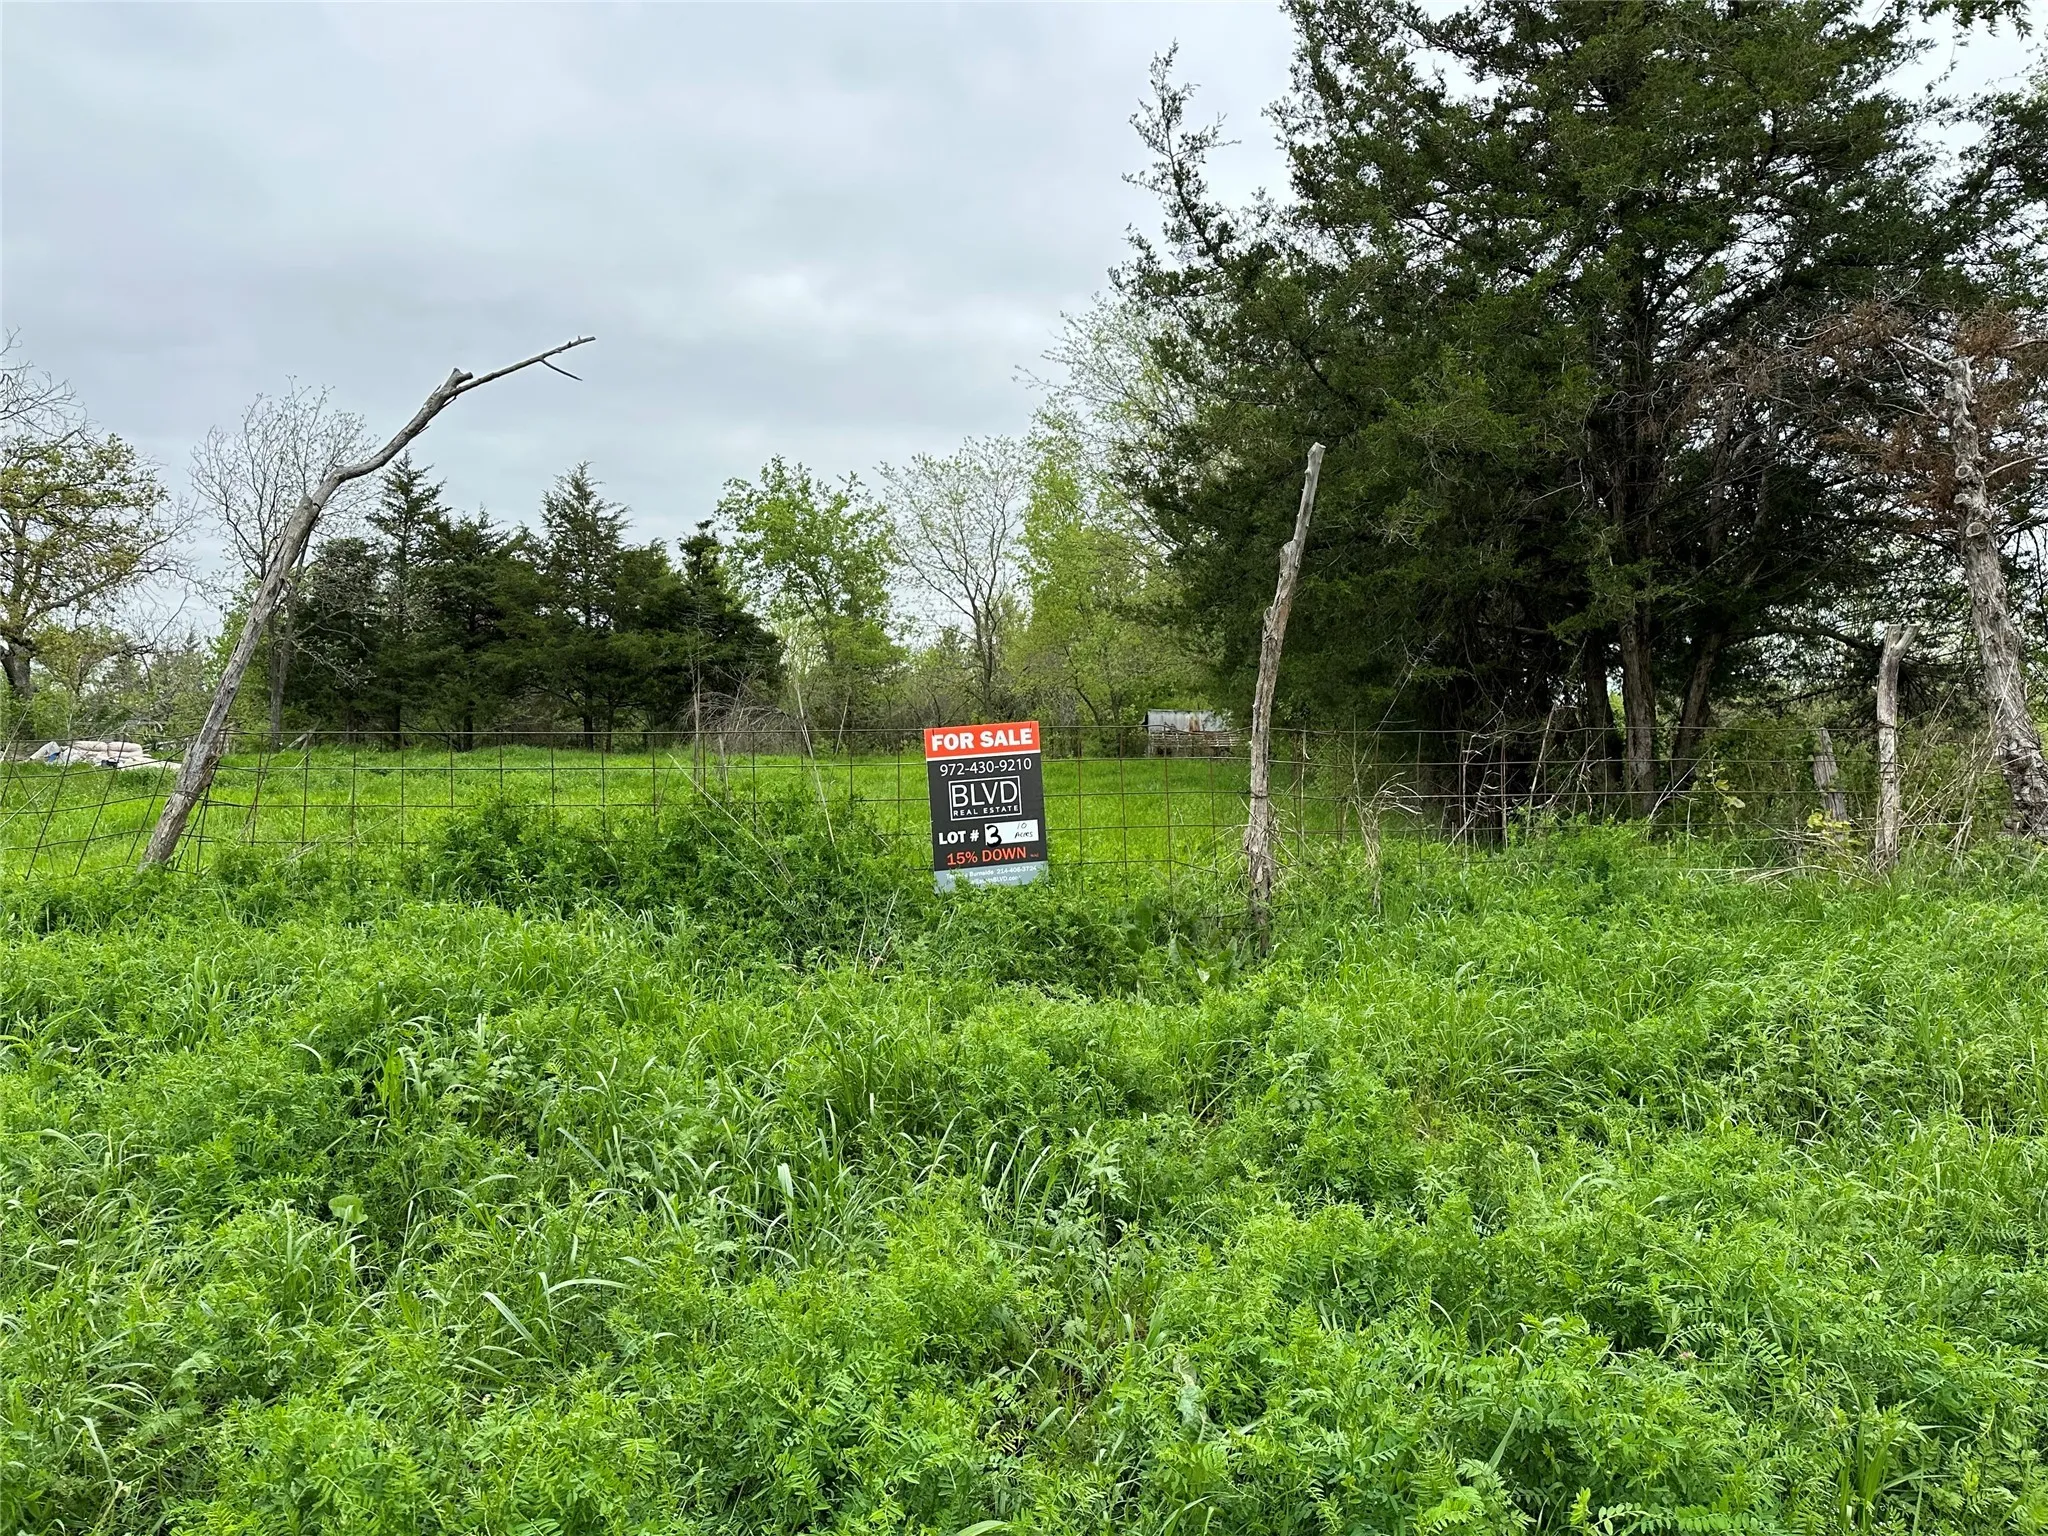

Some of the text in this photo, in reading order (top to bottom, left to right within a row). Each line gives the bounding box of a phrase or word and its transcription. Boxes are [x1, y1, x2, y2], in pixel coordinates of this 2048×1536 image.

[931, 728, 1033, 752] FOR SALE
[939, 757, 1032, 777] 972-430-9210
[951, 780, 1018, 808] BLVD
[953, 804, 1019, 817] REAL ESTATE
[986, 824, 1003, 848] 3
[1016, 822, 1028, 830] 10
[938, 829, 980, 845] LOT #
[946, 846, 1027, 866] 15% DOWN
